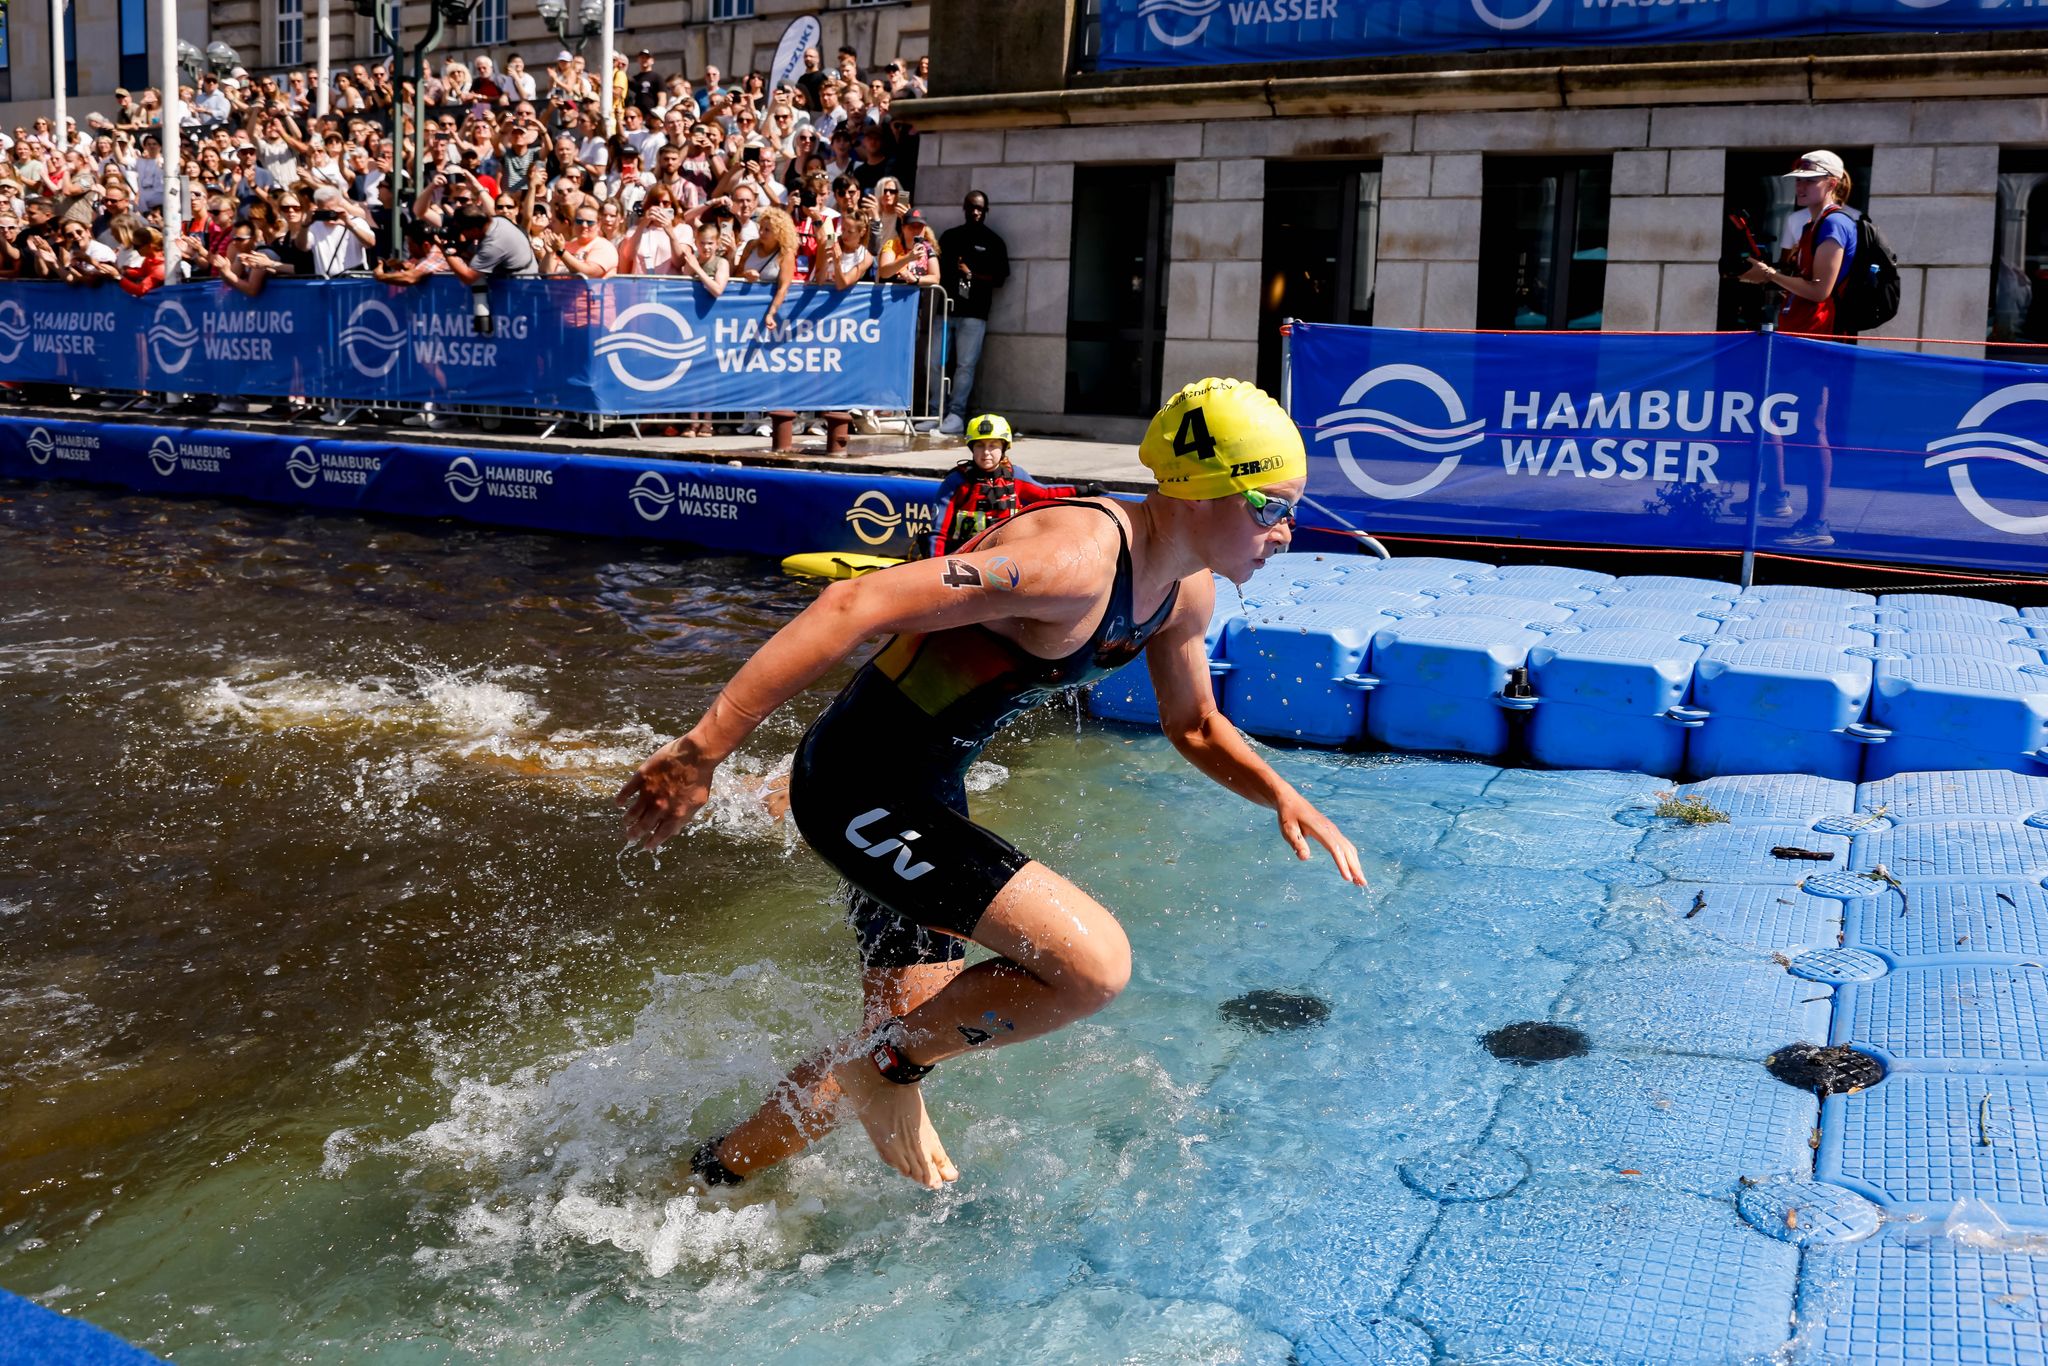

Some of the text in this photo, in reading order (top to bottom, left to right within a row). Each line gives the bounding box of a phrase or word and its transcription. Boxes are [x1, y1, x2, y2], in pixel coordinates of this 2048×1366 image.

[1229, 0, 1338, 26] WASSER
[33, 311, 115, 332] HAMBURG
[203, 311, 294, 334] HAMBURG
[715, 317, 880, 344] HAMBURG
[33, 334, 96, 355] WASSER
[204, 338, 273, 361] WASSER
[413, 341, 498, 367] WASSER
[715, 347, 843, 373] WASSER
[1501, 390, 1799, 436] HAMBURG
[55, 434, 100, 449] HAMBURG
[1173, 406, 1217, 460] 4
[55, 447, 91, 461] WASSER
[179, 443, 231, 460] HAMBURG
[321, 453, 381, 471] HAMBURG
[1501, 438, 1720, 484] WASSER
[180, 458, 221, 473] WASSER
[485, 466, 554, 485] HAMBURG
[322, 469, 368, 486] WASSER
[486, 482, 538, 500] WASSER
[678, 481, 757, 504] HAMBURG
[678, 499, 738, 520] WASSER
[941, 558, 984, 590] 4
